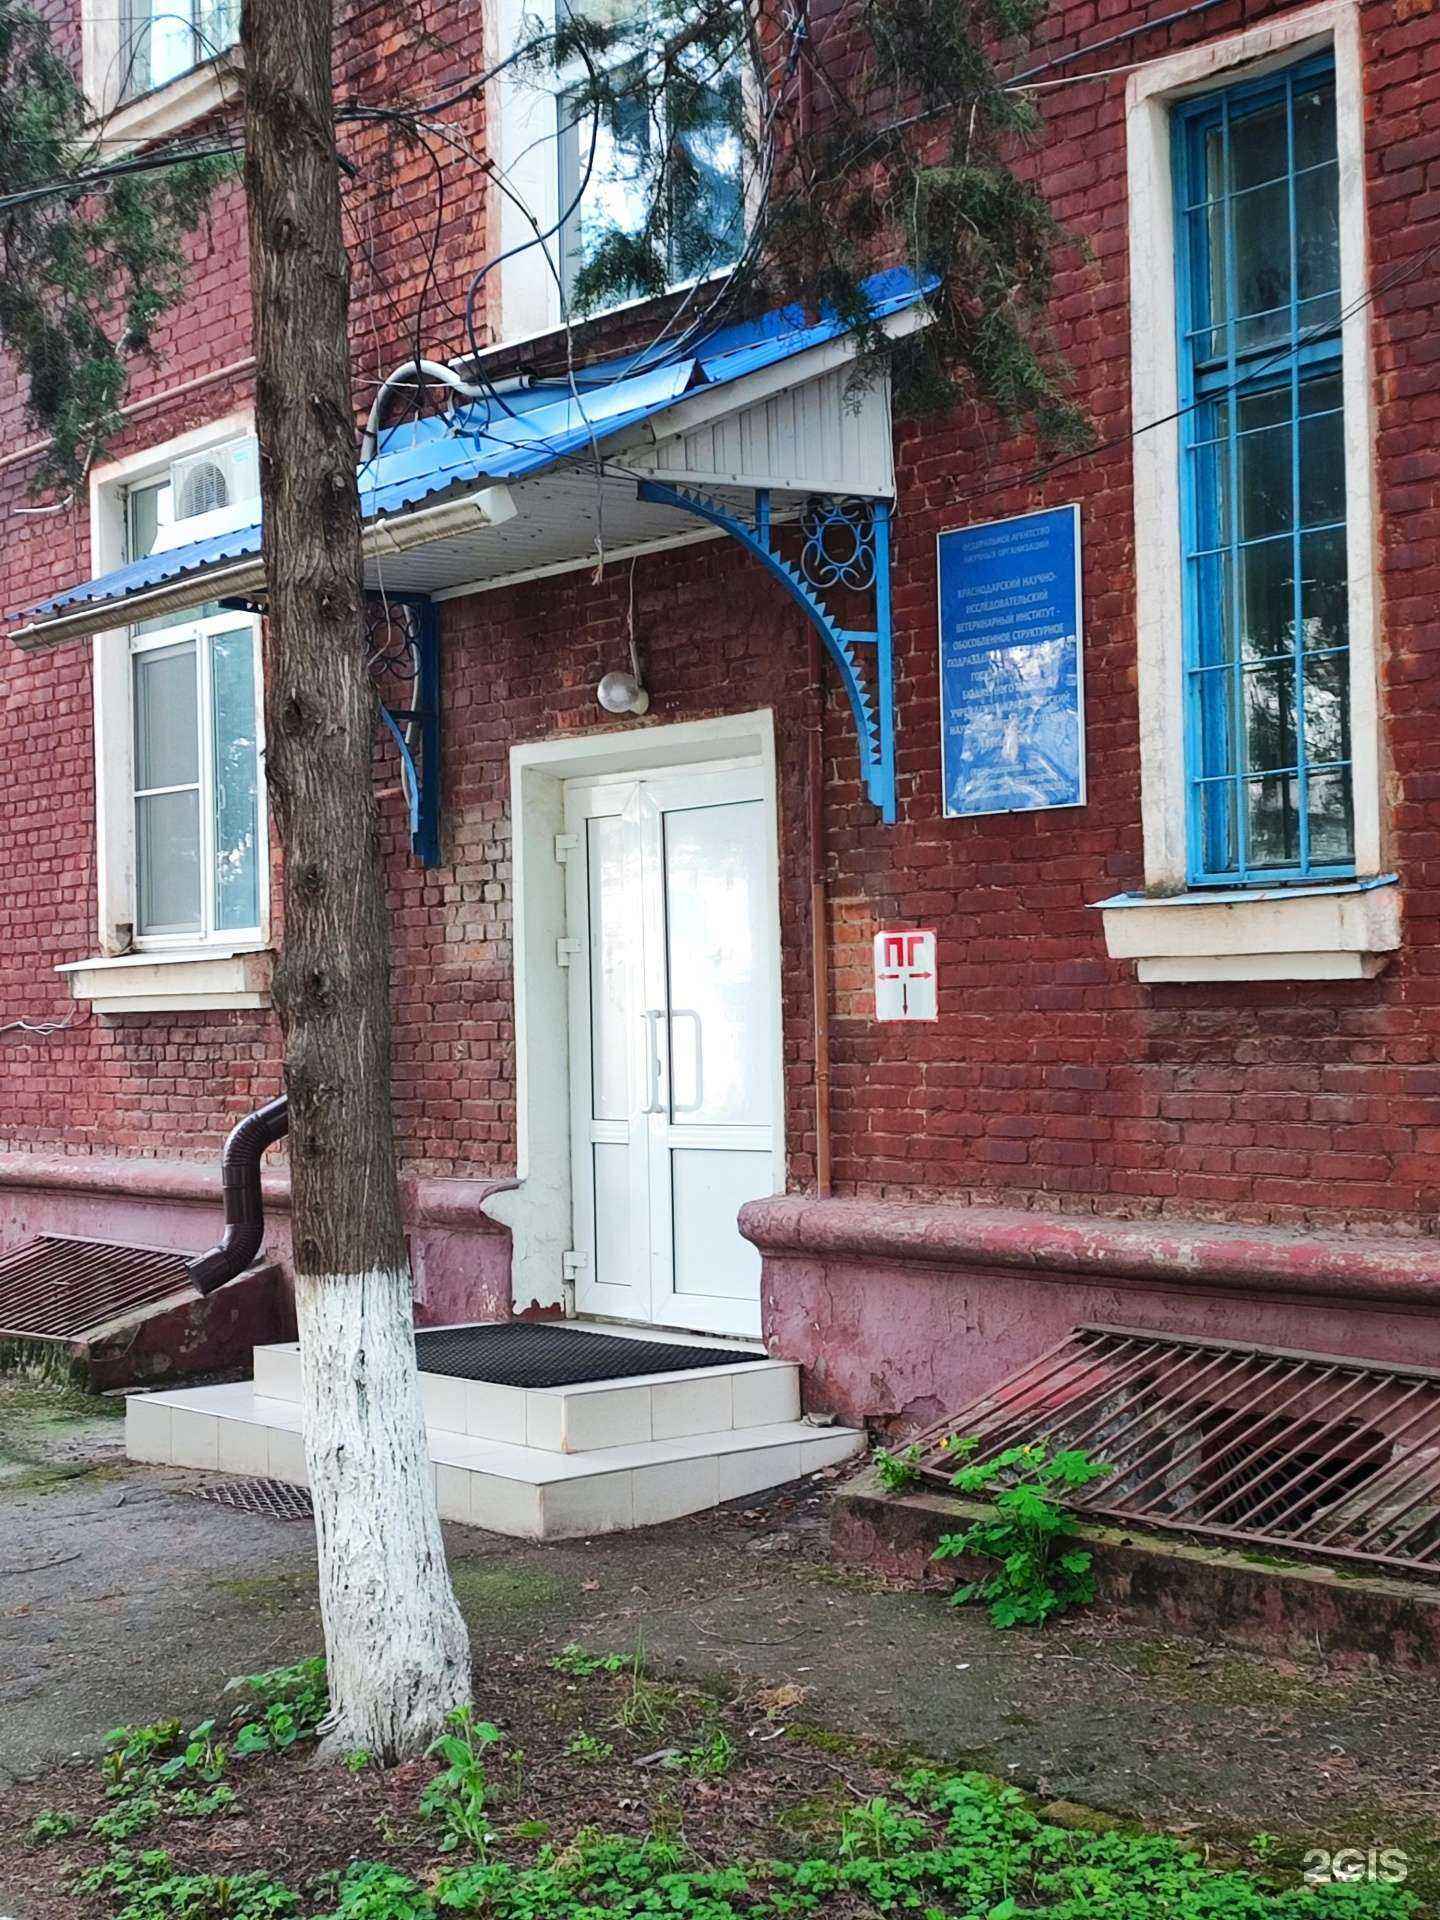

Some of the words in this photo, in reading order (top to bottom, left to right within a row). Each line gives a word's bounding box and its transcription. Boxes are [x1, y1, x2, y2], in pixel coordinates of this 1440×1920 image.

[957, 577, 1021, 598] КРАСНОДАРСКИЙ
[1022, 571, 1057, 587] НАУЧНО-
[965, 589, 1049, 614] ИССЛЕДОВАТЕЛЬСКИЙ
[955, 612, 1015, 633] ВЕТЕРИНАРНЫЙ
[1015, 606, 1055, 622] ИНСТИТУТ
[952, 632, 1011, 650] ОБОСОБЛЕННОЕ
[1012, 622, 1065, 640] СТРУКТУРНОЕ
[884, 936, 924, 967] ПГ
